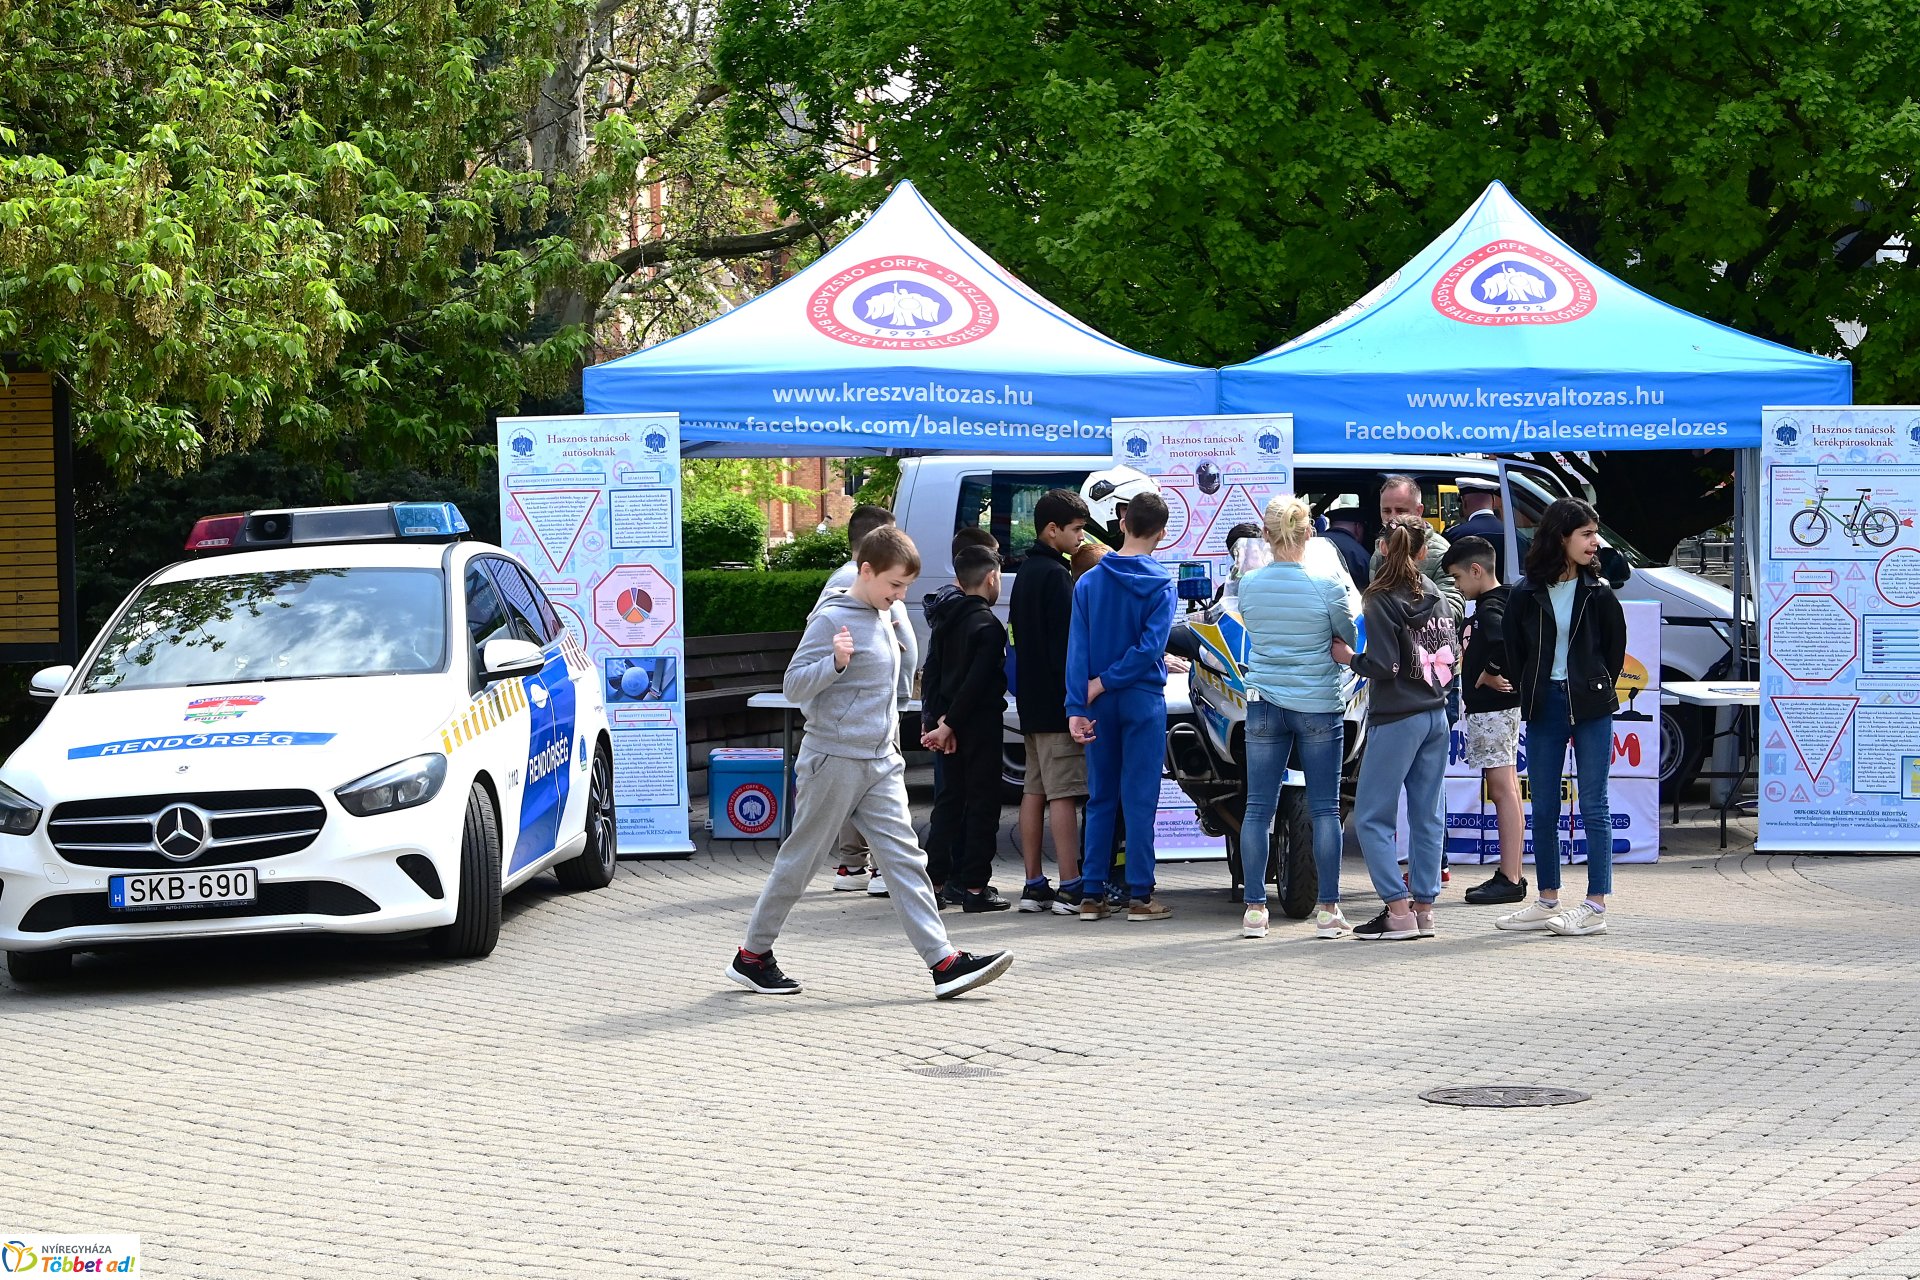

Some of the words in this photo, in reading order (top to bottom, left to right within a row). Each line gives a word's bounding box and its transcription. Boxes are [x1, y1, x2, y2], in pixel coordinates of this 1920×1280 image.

[1486, 243, 1529, 254] ORFK
[880, 258, 932, 271] ORFK
[1437, 258, 1475, 307] ORSZÁGOS
[1542, 256, 1592, 302] BIZOTTSÁG
[812, 268, 865, 319] ORSZÁGOS
[944, 274, 994, 326] BIZOTTSÁG
[1445, 301, 1589, 324] BALESETMEGELŐZÉSI
[1494, 305, 1546, 313] 1992
[817, 318, 989, 348] BALESETMEGELŐZÉSI
[874, 328, 934, 337] 1992
[772, 382, 1033, 406] www.kreszvaltozas.hu
[1406, 385, 1665, 408] www.kreszvaltozas.hu
[547, 434, 588, 444] Hasznos
[589, 432, 631, 443] tanácsok
[1162, 435, 1201, 445] Hasznos
[1204, 433, 1244, 444] tanácsok
[1345, 417, 1729, 443] Facebook.com/balesetmegelozes
[1811, 424, 1853, 434] Hasznos
[1854, 424, 1896, 435] tanácsok
[562, 447, 616, 457] autósoknak
[1170, 448, 1236, 458] motorosoknak
[1813, 436, 1894, 448] kerékpárosoknak
[99, 732, 294, 756] RENDŐRSÉG
[528, 731, 569, 786] RENDŐRSÉG
[114, 893, 122, 903] H
[130, 872, 248, 903] SKB-690
